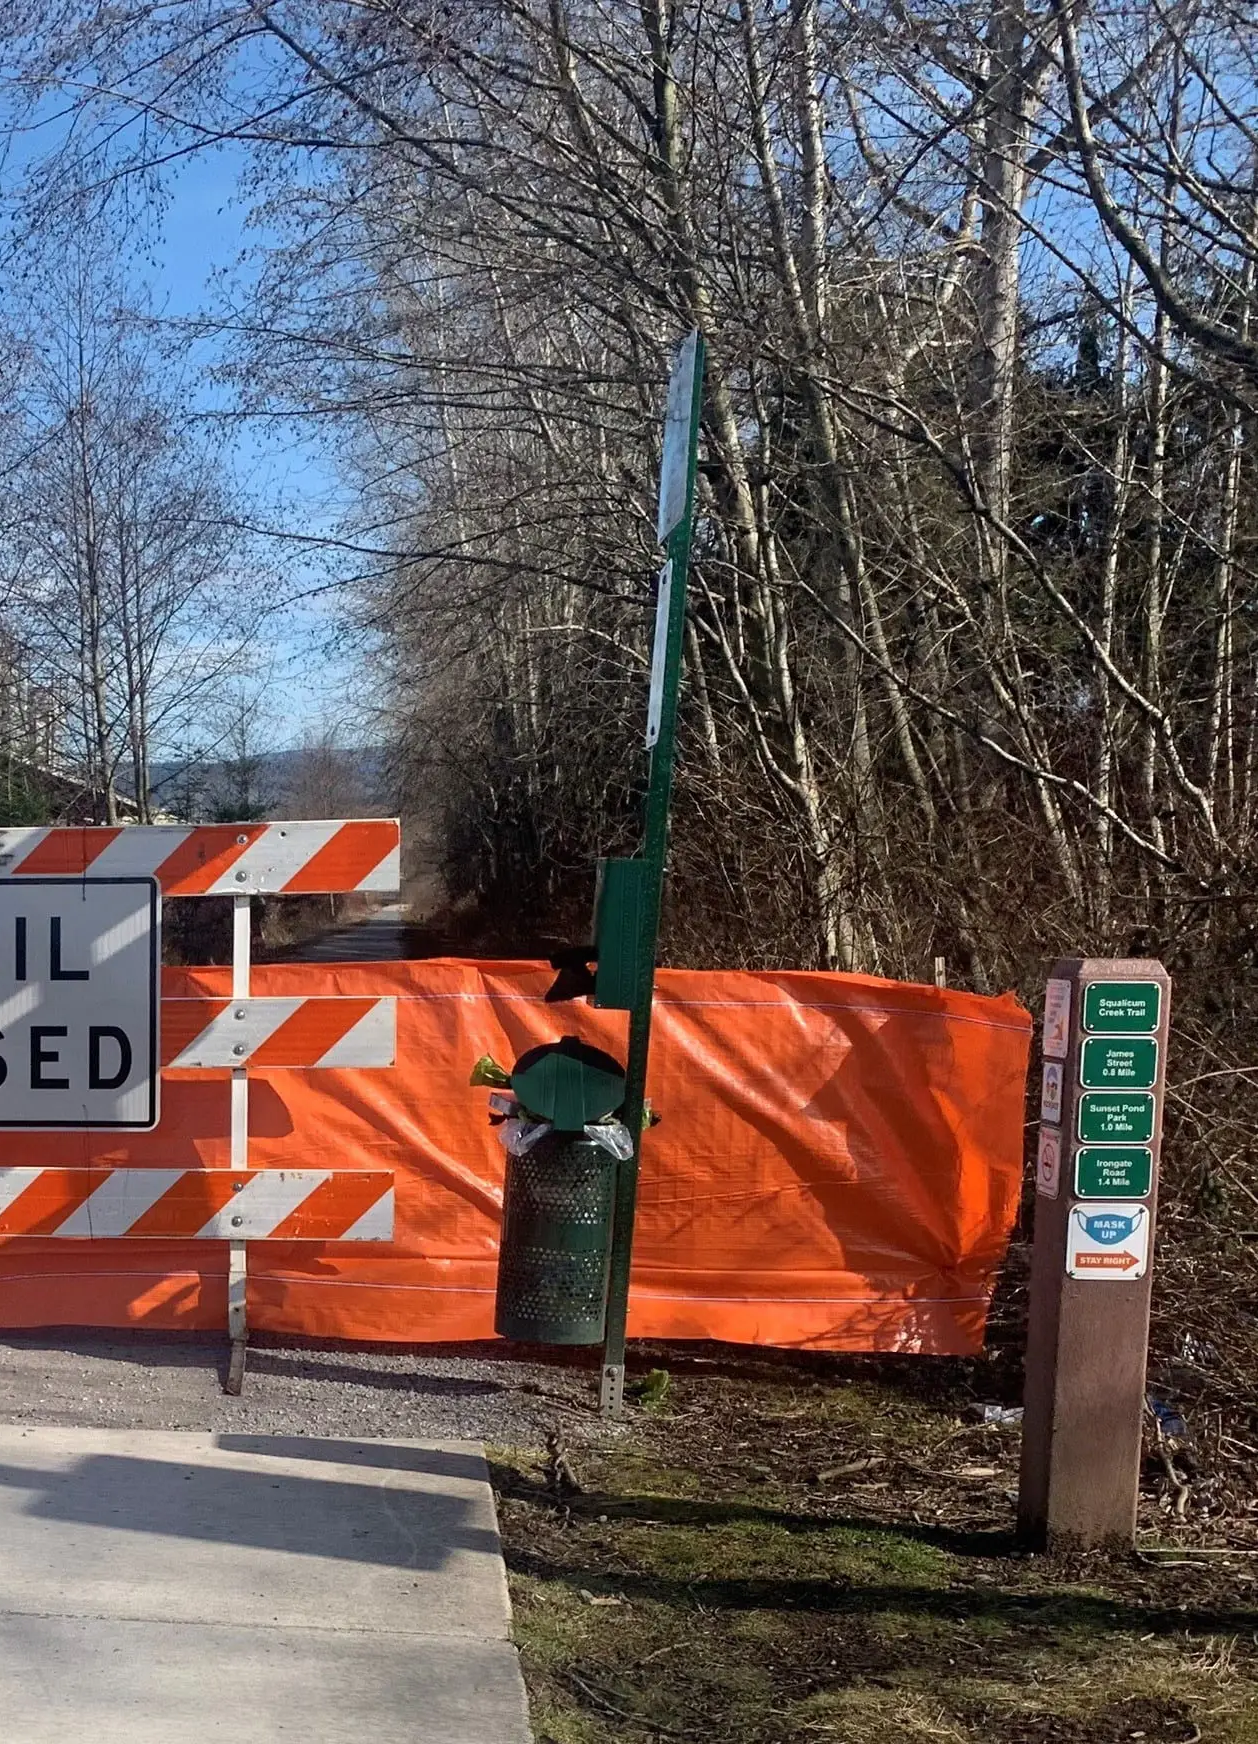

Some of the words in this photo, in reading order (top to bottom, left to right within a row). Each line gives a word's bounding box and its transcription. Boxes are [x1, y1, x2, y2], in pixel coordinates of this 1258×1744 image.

[1099, 998, 1146, 1008] Squalicum
[1098, 1008, 1125, 1017] Creek
[1126, 1008, 1146, 1017] Trail
[1106, 1049, 1134, 1058] James
[1106, 1058, 1133, 1068] Street
[1117, 1068, 1136, 1077] Mile
[1090, 1104, 1120, 1113] Sunset
[1122, 1104, 1145, 1113] Pond
[1107, 1113, 1127, 1122] Park
[1100, 1122, 1114, 1132] 1.0
[1115, 1122, 1133, 1132] Mile
[1096, 1159, 1133, 1170] Irongate
[1103, 1168, 1126, 1177] Road
[1097, 1177, 1111, 1187] 1.4
[1112, 1177, 1130, 1187] Mile
[1093, 1220, 1126, 1230] MASK
[1101, 1230, 1117, 1240] UP
[1079, 1256, 1102, 1266] STAY
[1103, 1256, 1132, 1266] RIGHT
